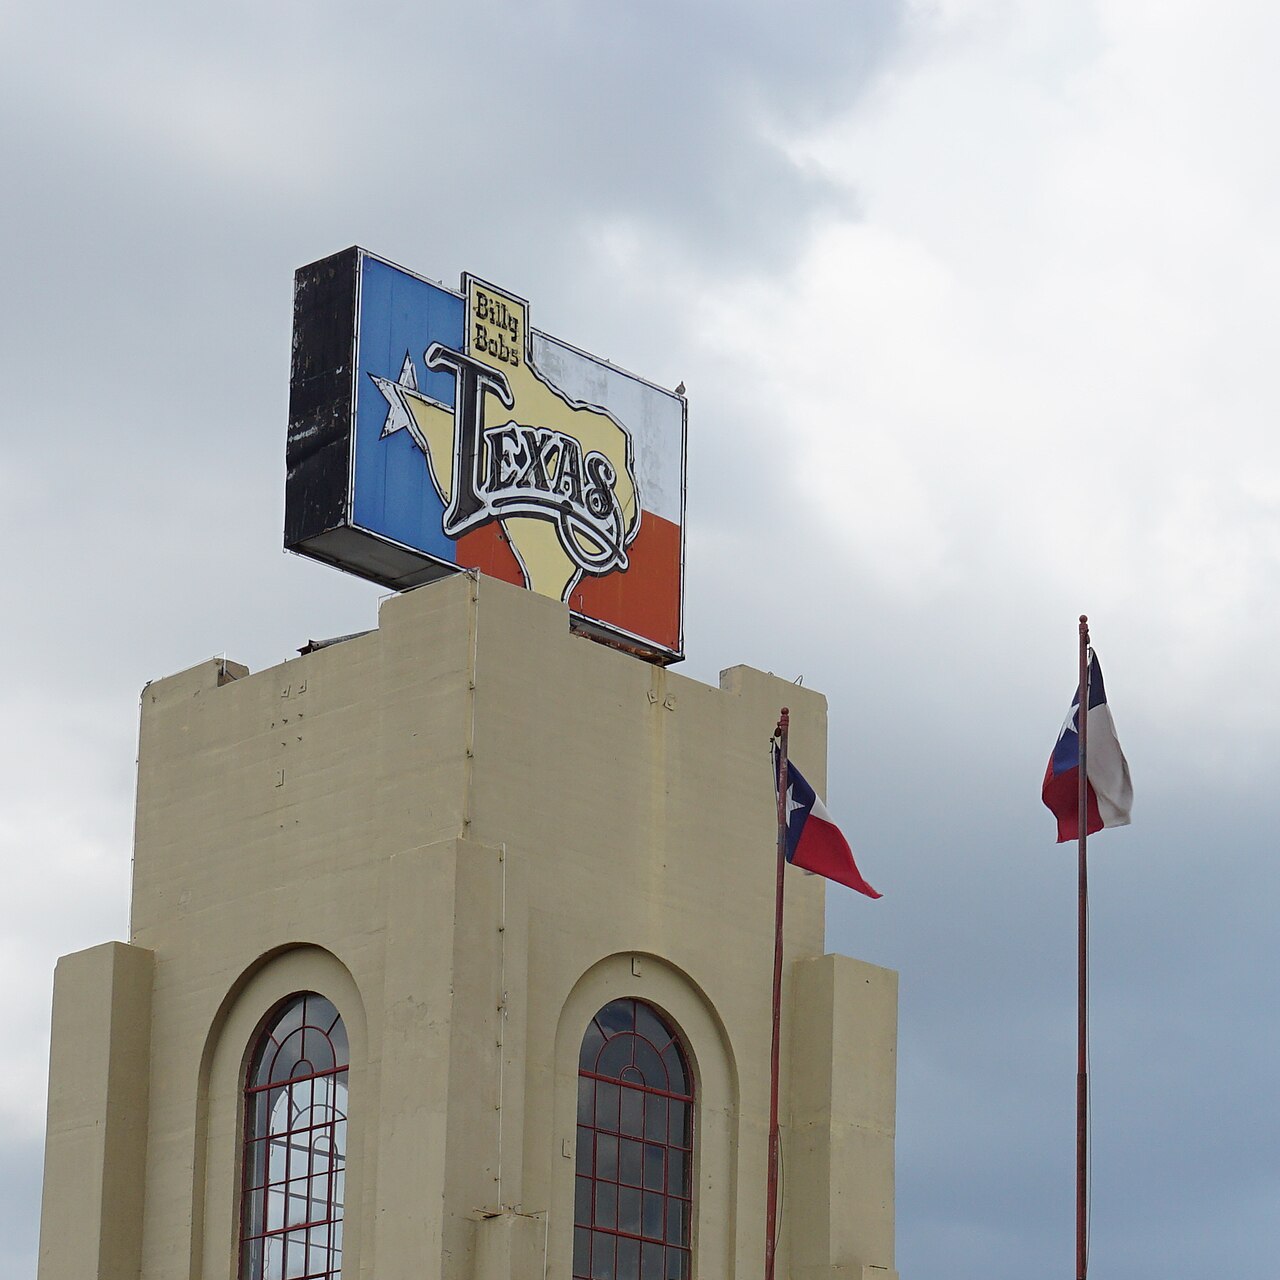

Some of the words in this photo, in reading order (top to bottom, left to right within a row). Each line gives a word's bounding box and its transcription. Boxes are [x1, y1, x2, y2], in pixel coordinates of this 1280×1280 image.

[476, 291, 518, 342] Billy
[475, 323, 518, 367] Bobs
[424, 341, 621, 541] TEXAS
